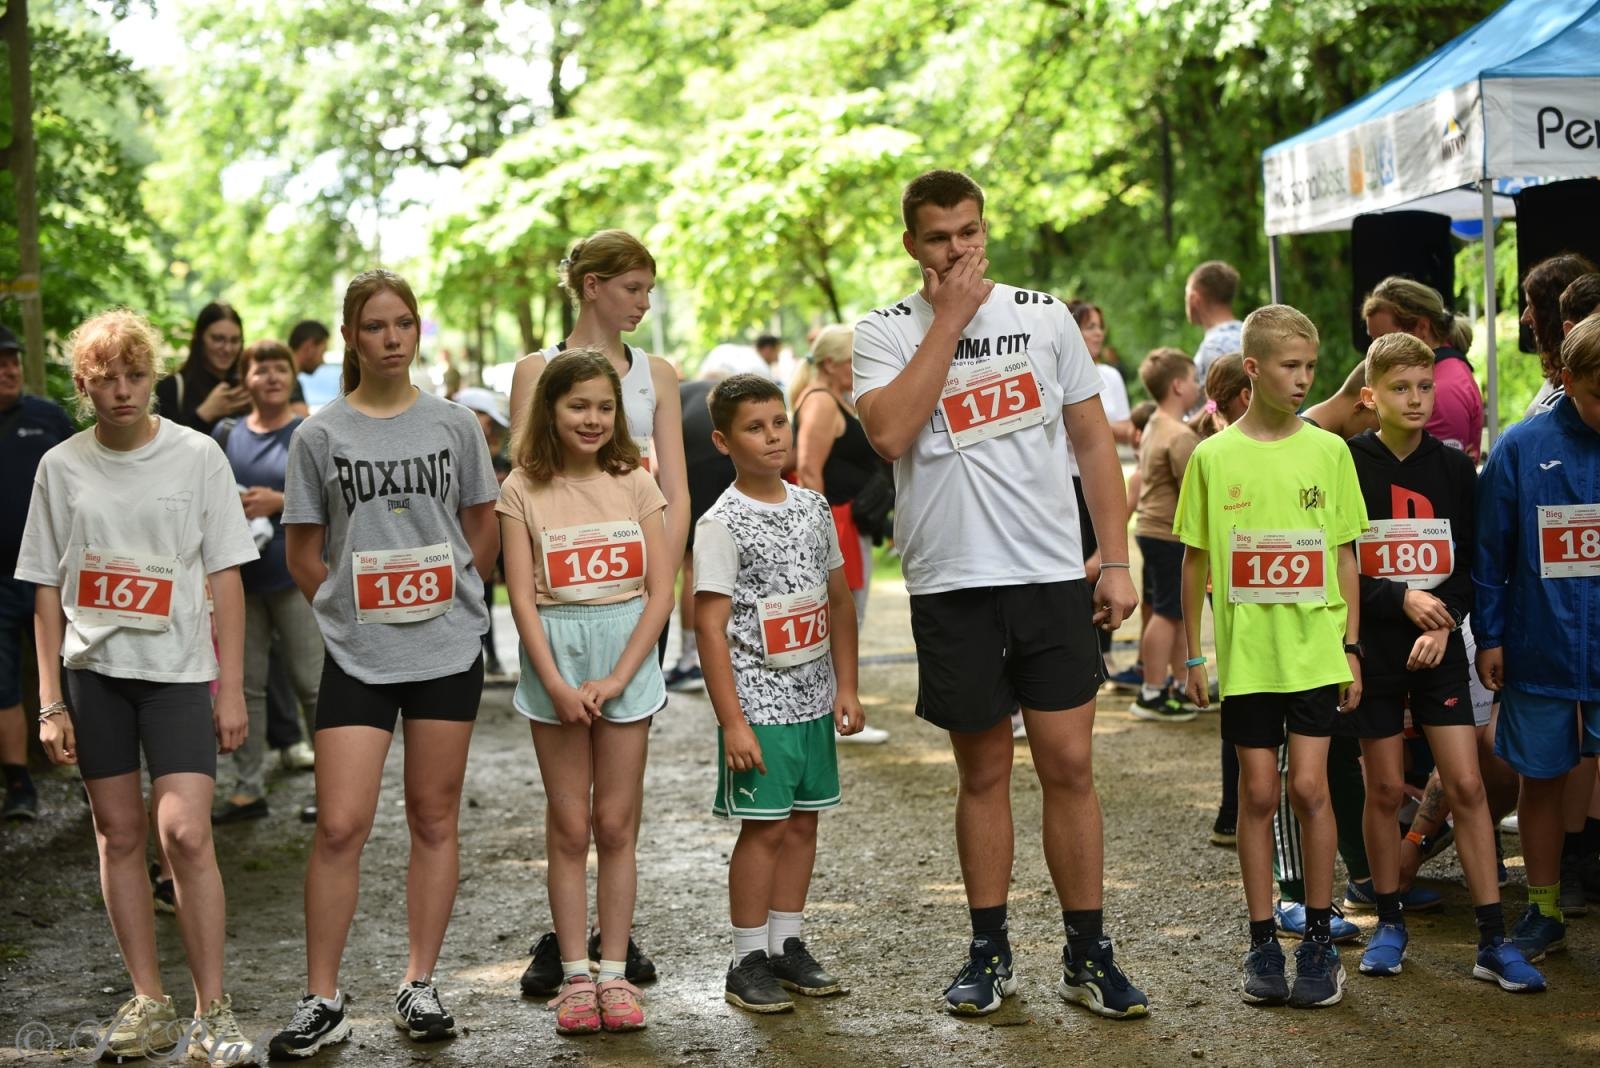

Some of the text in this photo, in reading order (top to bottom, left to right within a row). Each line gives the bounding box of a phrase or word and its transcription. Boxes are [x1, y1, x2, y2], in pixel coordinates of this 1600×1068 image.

[996, 333, 1031, 356] CITY
[1004, 363, 1021, 373] 4500
[961, 379, 1026, 425] 175
[333, 448, 451, 518] BOXING
[1545, 510, 1563, 519] Bieg
[549, 534, 567, 543] Bieg
[612, 530, 631, 538] 4500
[1236, 534, 1252, 543] Bieg
[1559, 529, 1600, 559] 18
[85, 553, 101, 563] Bieg
[360, 557, 378, 565] Bieg
[423, 554, 442, 563] 4500
[564, 546, 629, 582] 165
[1375, 543, 1438, 573] 180
[145, 565, 173, 575] 4500 M
[1246, 554, 1310, 585] 169
[93, 575, 159, 610] 167
[374, 571, 440, 606] 168
[765, 601, 782, 610] Bieg
[780, 609, 827, 649] 178
